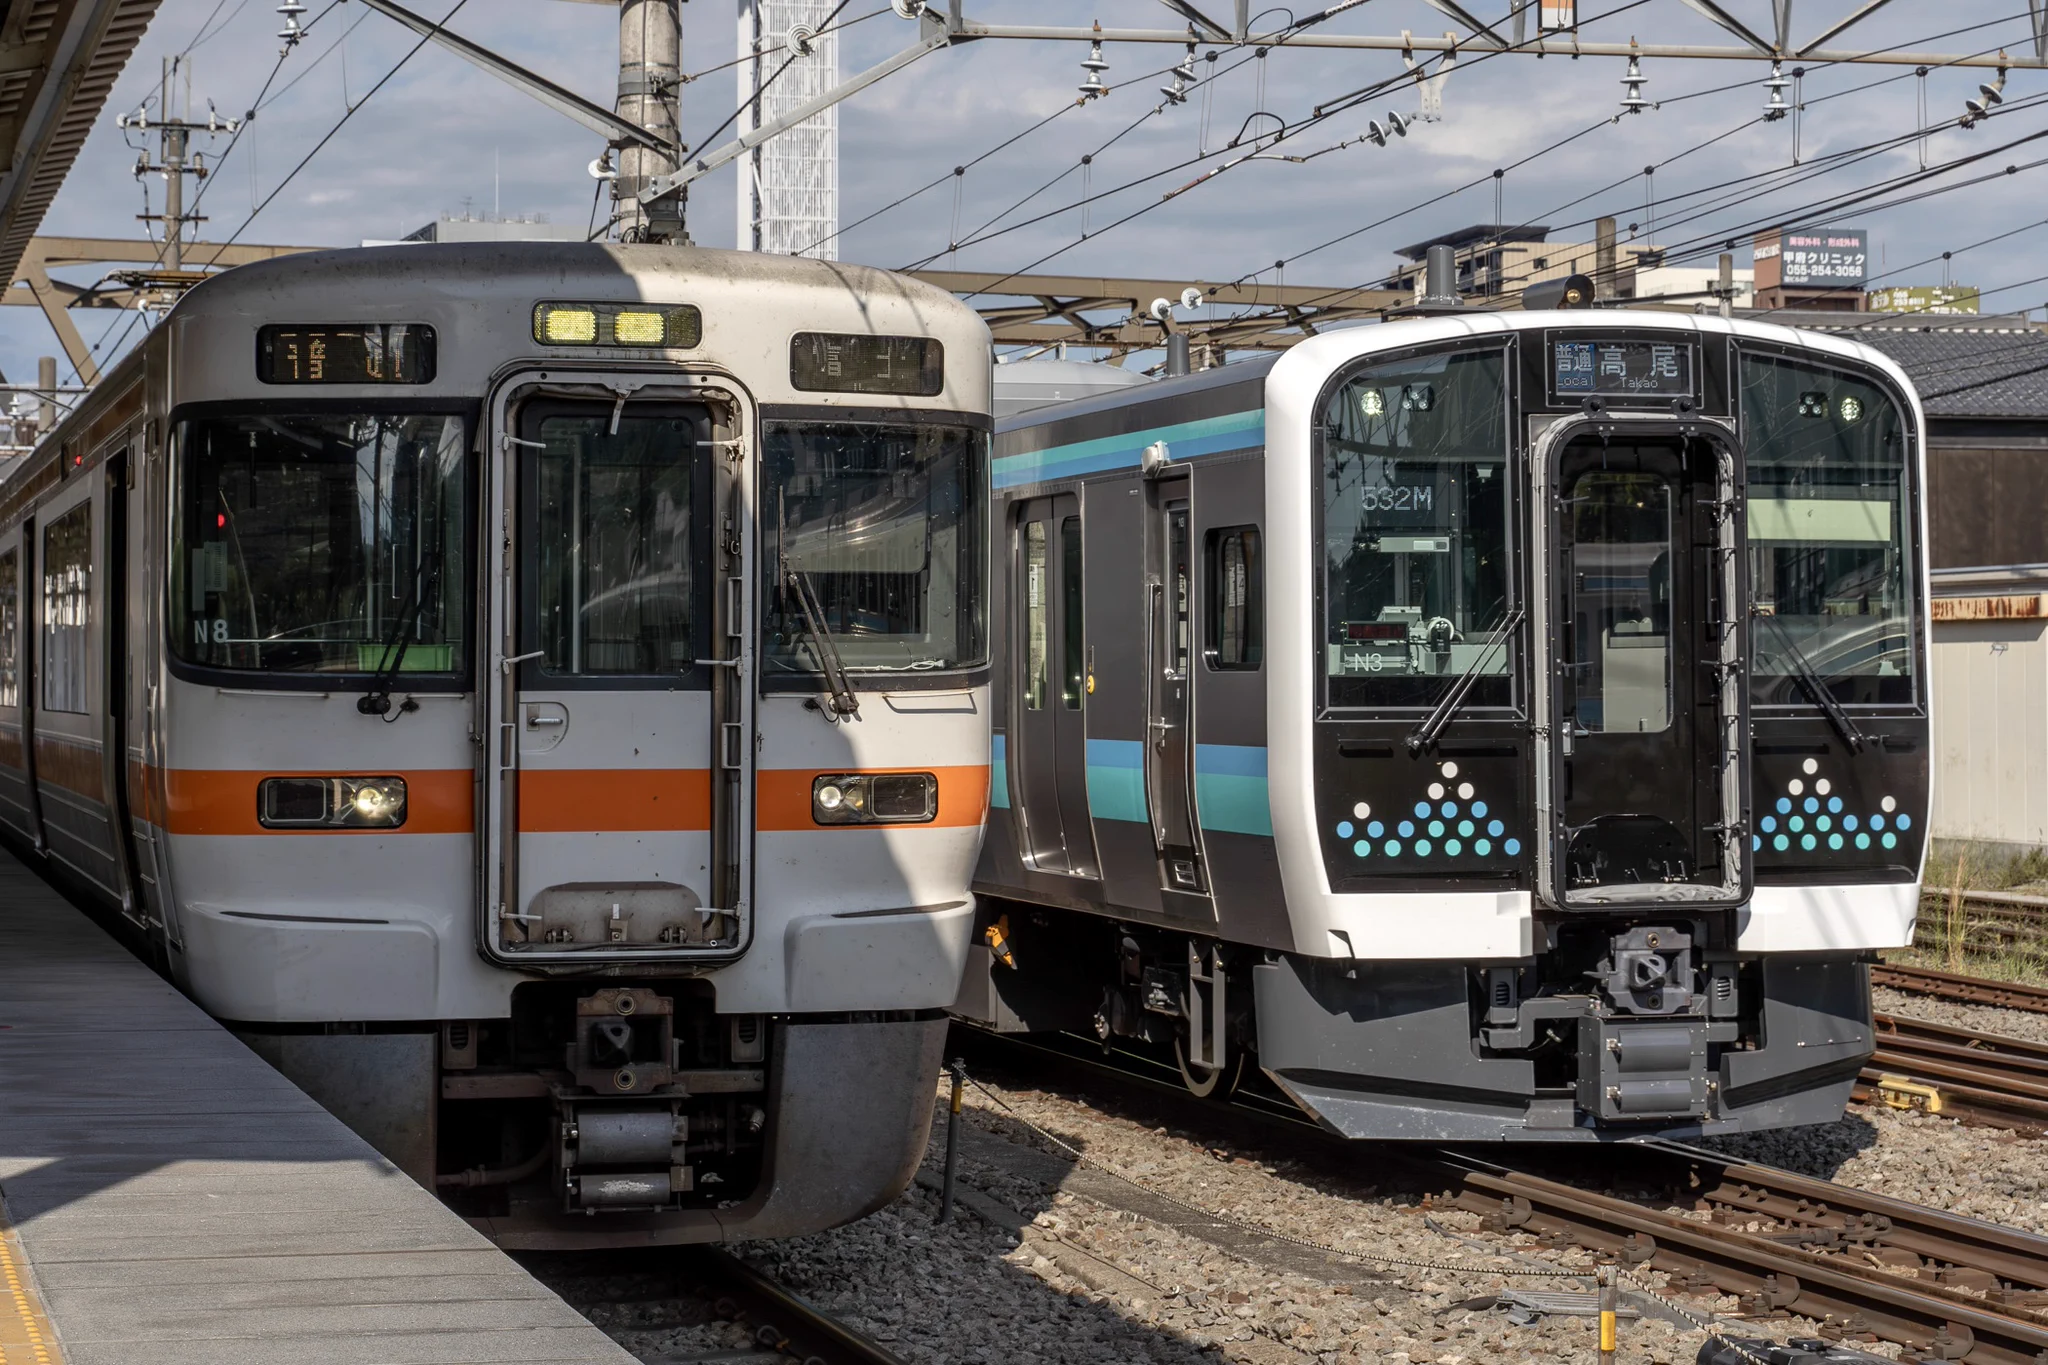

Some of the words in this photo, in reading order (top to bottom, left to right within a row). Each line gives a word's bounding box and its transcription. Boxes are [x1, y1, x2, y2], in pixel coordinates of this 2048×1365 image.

[1783, 251, 1865, 265] 甲府クリニック
[1786, 264, 1862, 277] 055-254-3056
[1556, 344, 1593, 372] 普通
[1598, 345, 1678, 377] 高尾
[1620, 377, 1659, 388] Takao
[1360, 486, 1432, 511] 532M
[194, 619, 228, 644] N8
[1354, 653, 1382, 672] N3
